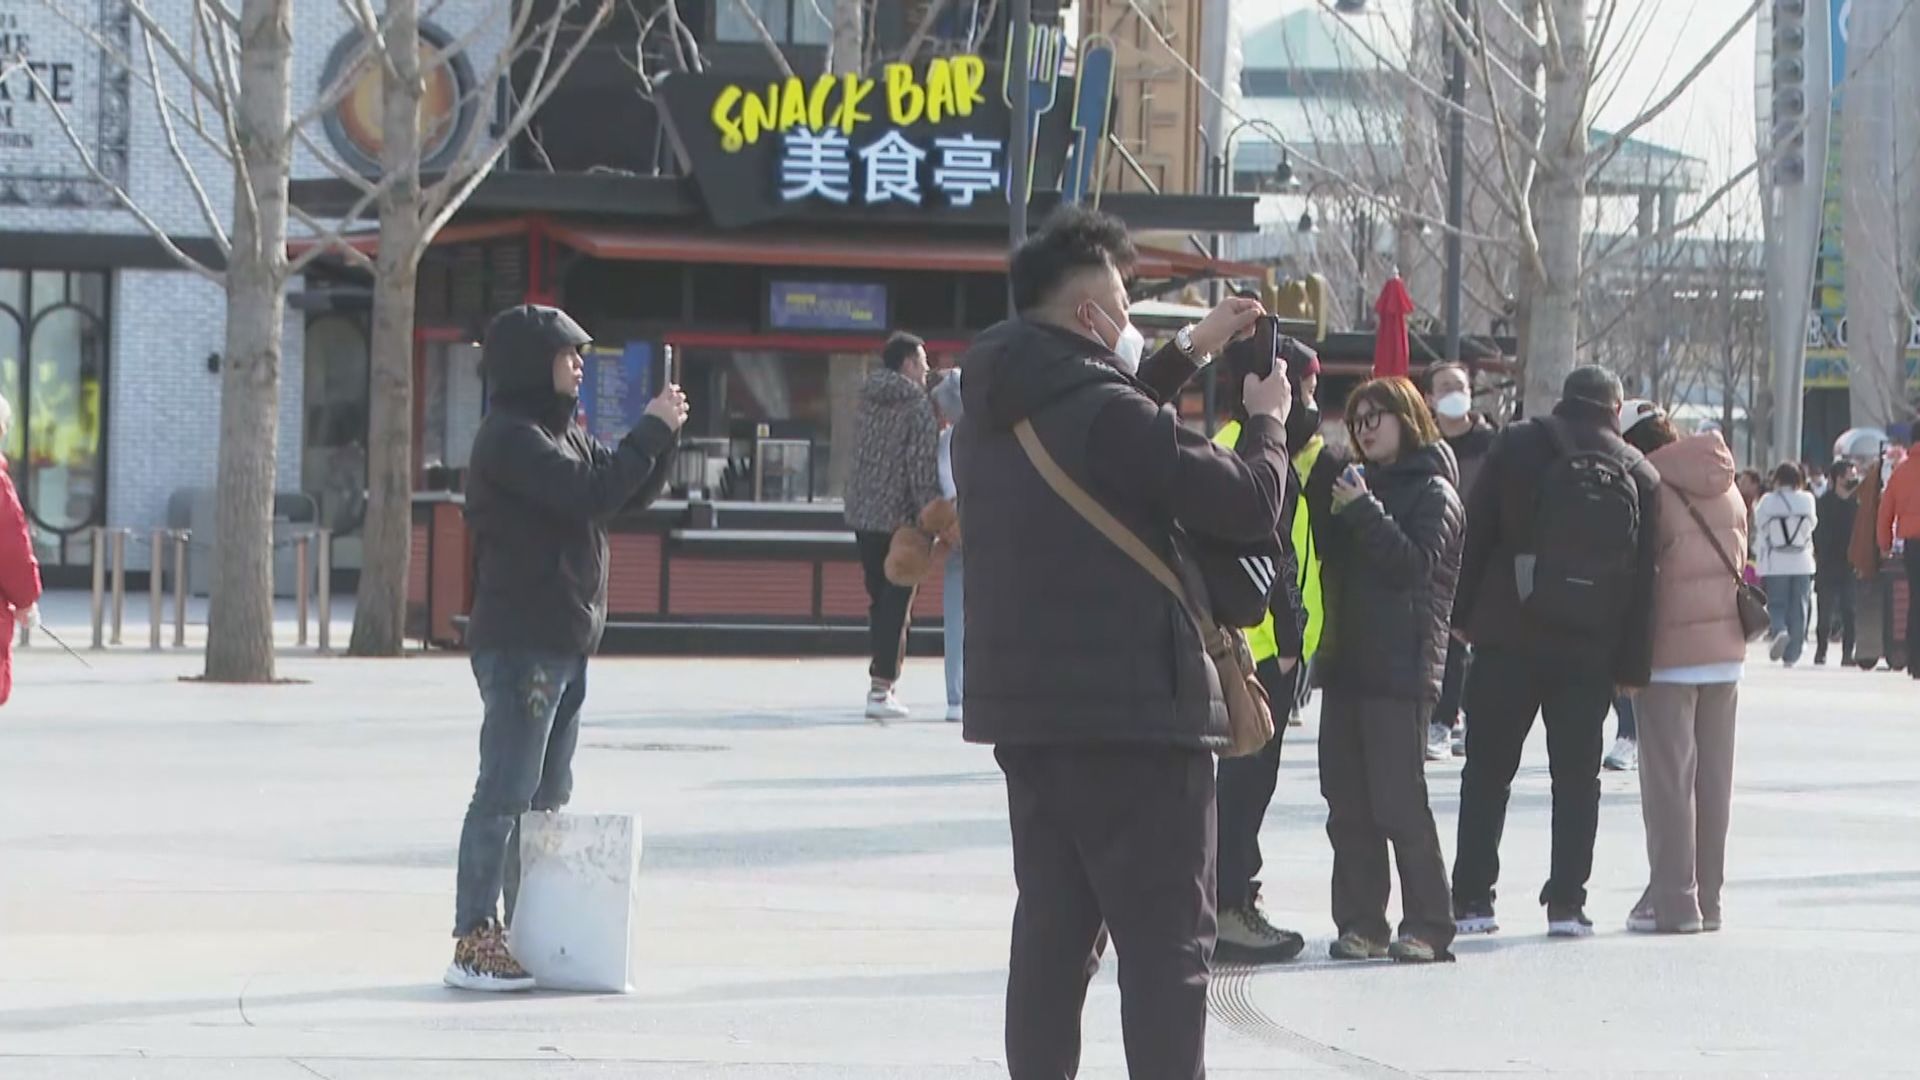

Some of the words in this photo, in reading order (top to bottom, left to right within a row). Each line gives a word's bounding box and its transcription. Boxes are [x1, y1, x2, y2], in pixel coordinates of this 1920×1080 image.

[712, 74, 875, 152] SNACK
[885, 55, 986, 126] BAR
[782, 128, 1001, 206] 美食亭
